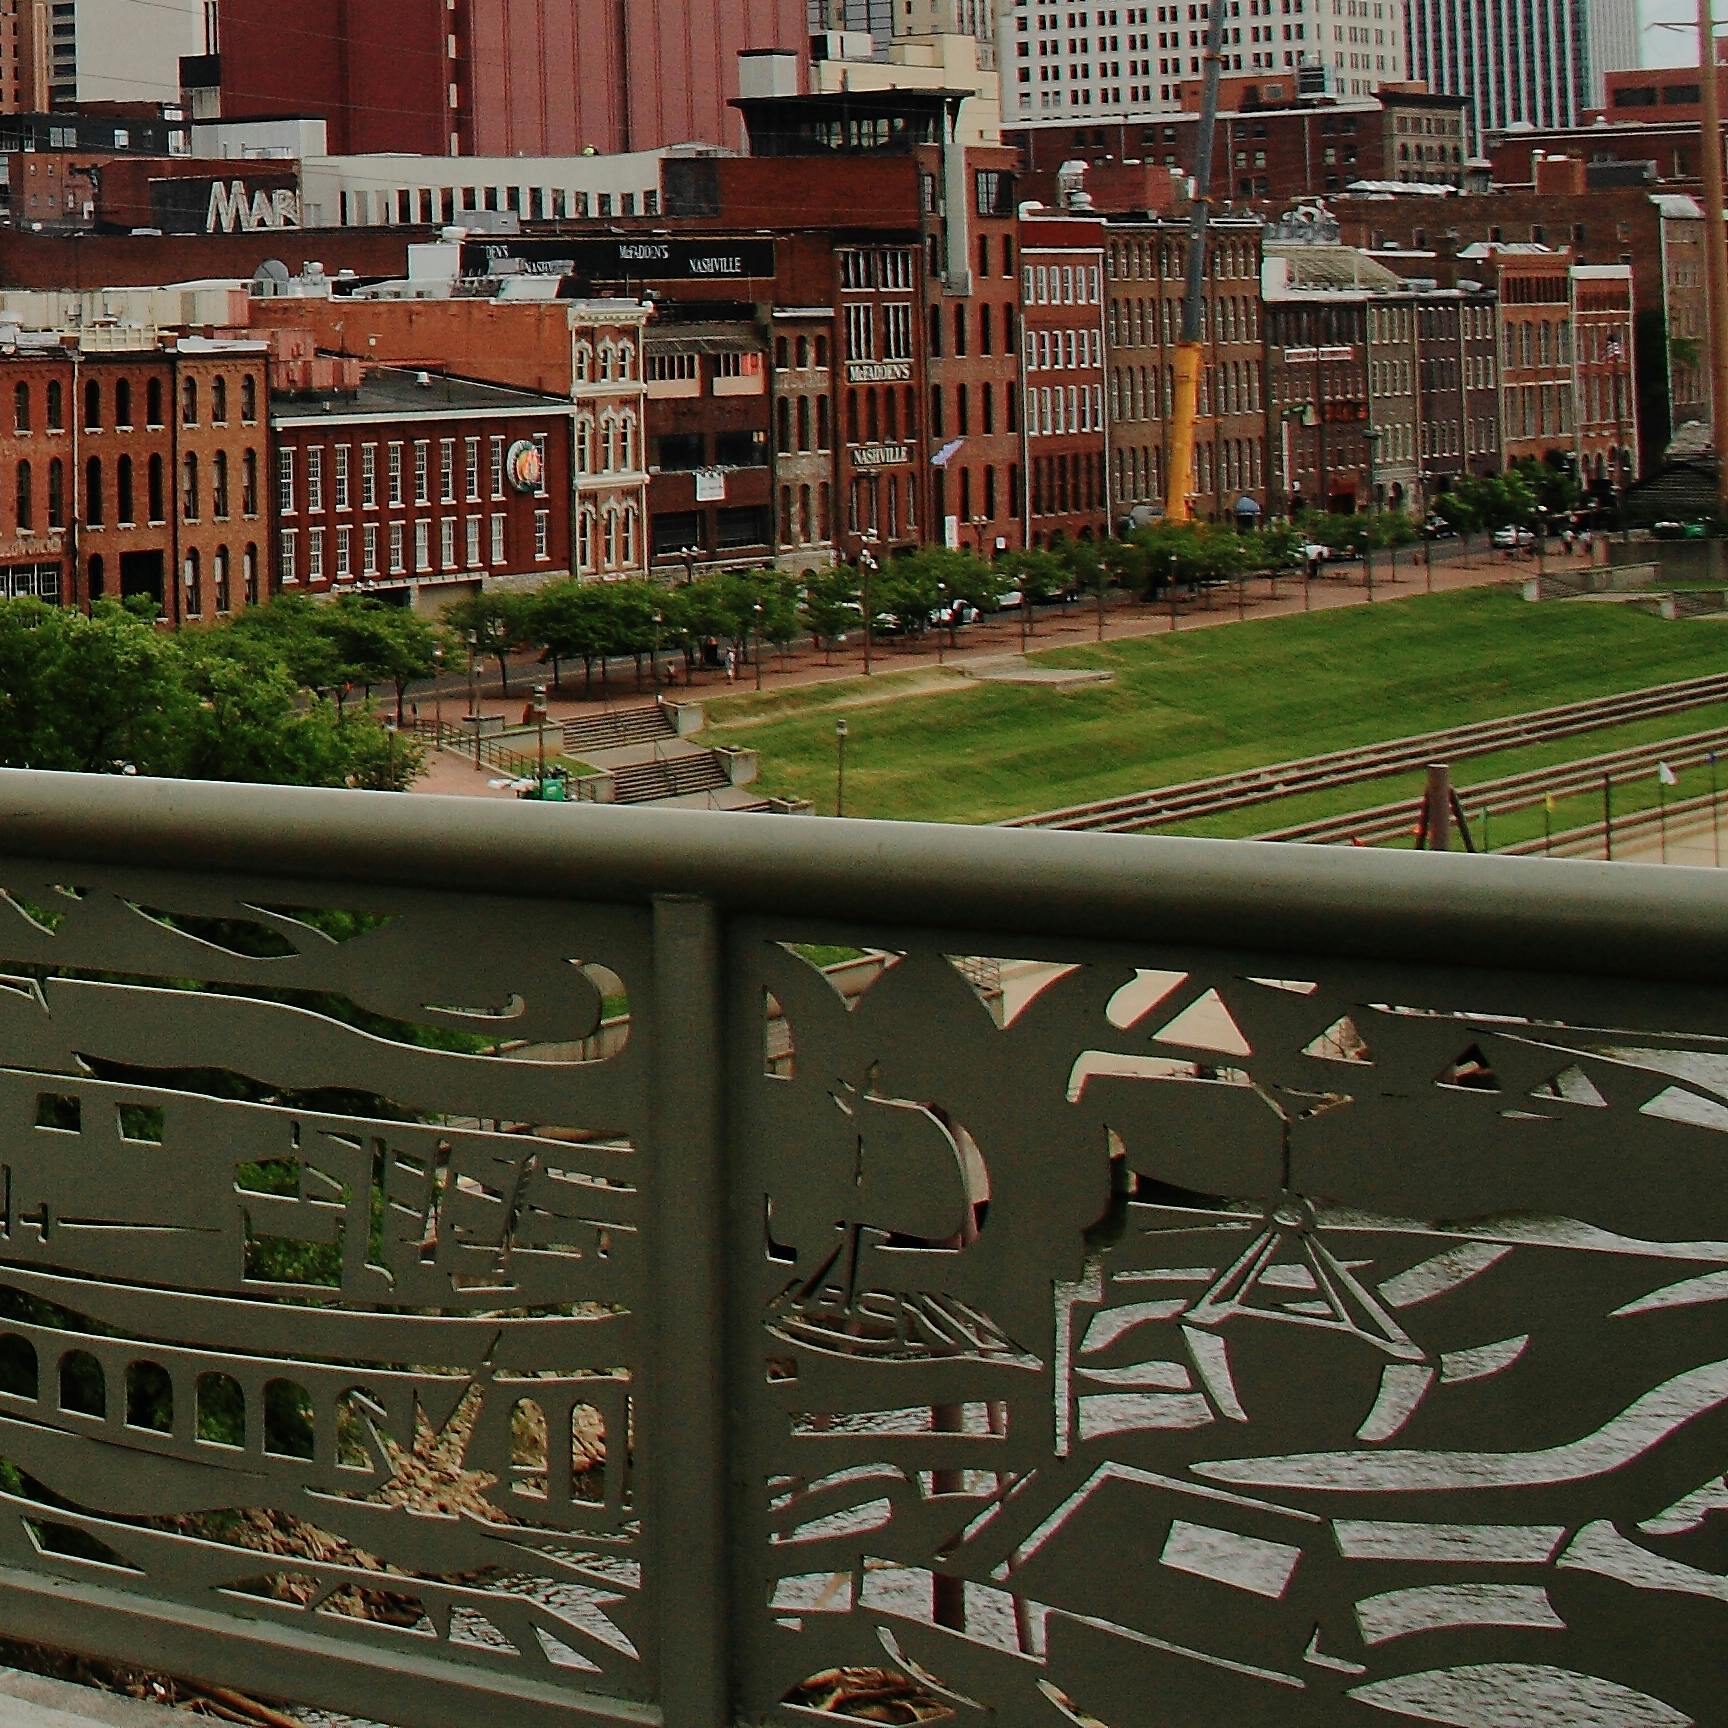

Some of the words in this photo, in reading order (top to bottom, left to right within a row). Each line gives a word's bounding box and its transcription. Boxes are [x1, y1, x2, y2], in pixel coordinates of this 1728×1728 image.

[206, 180, 303, 232] MAR
[689, 257, 742, 273] NASHVILLE
[853, 446, 908, 465] NASHVILLE
